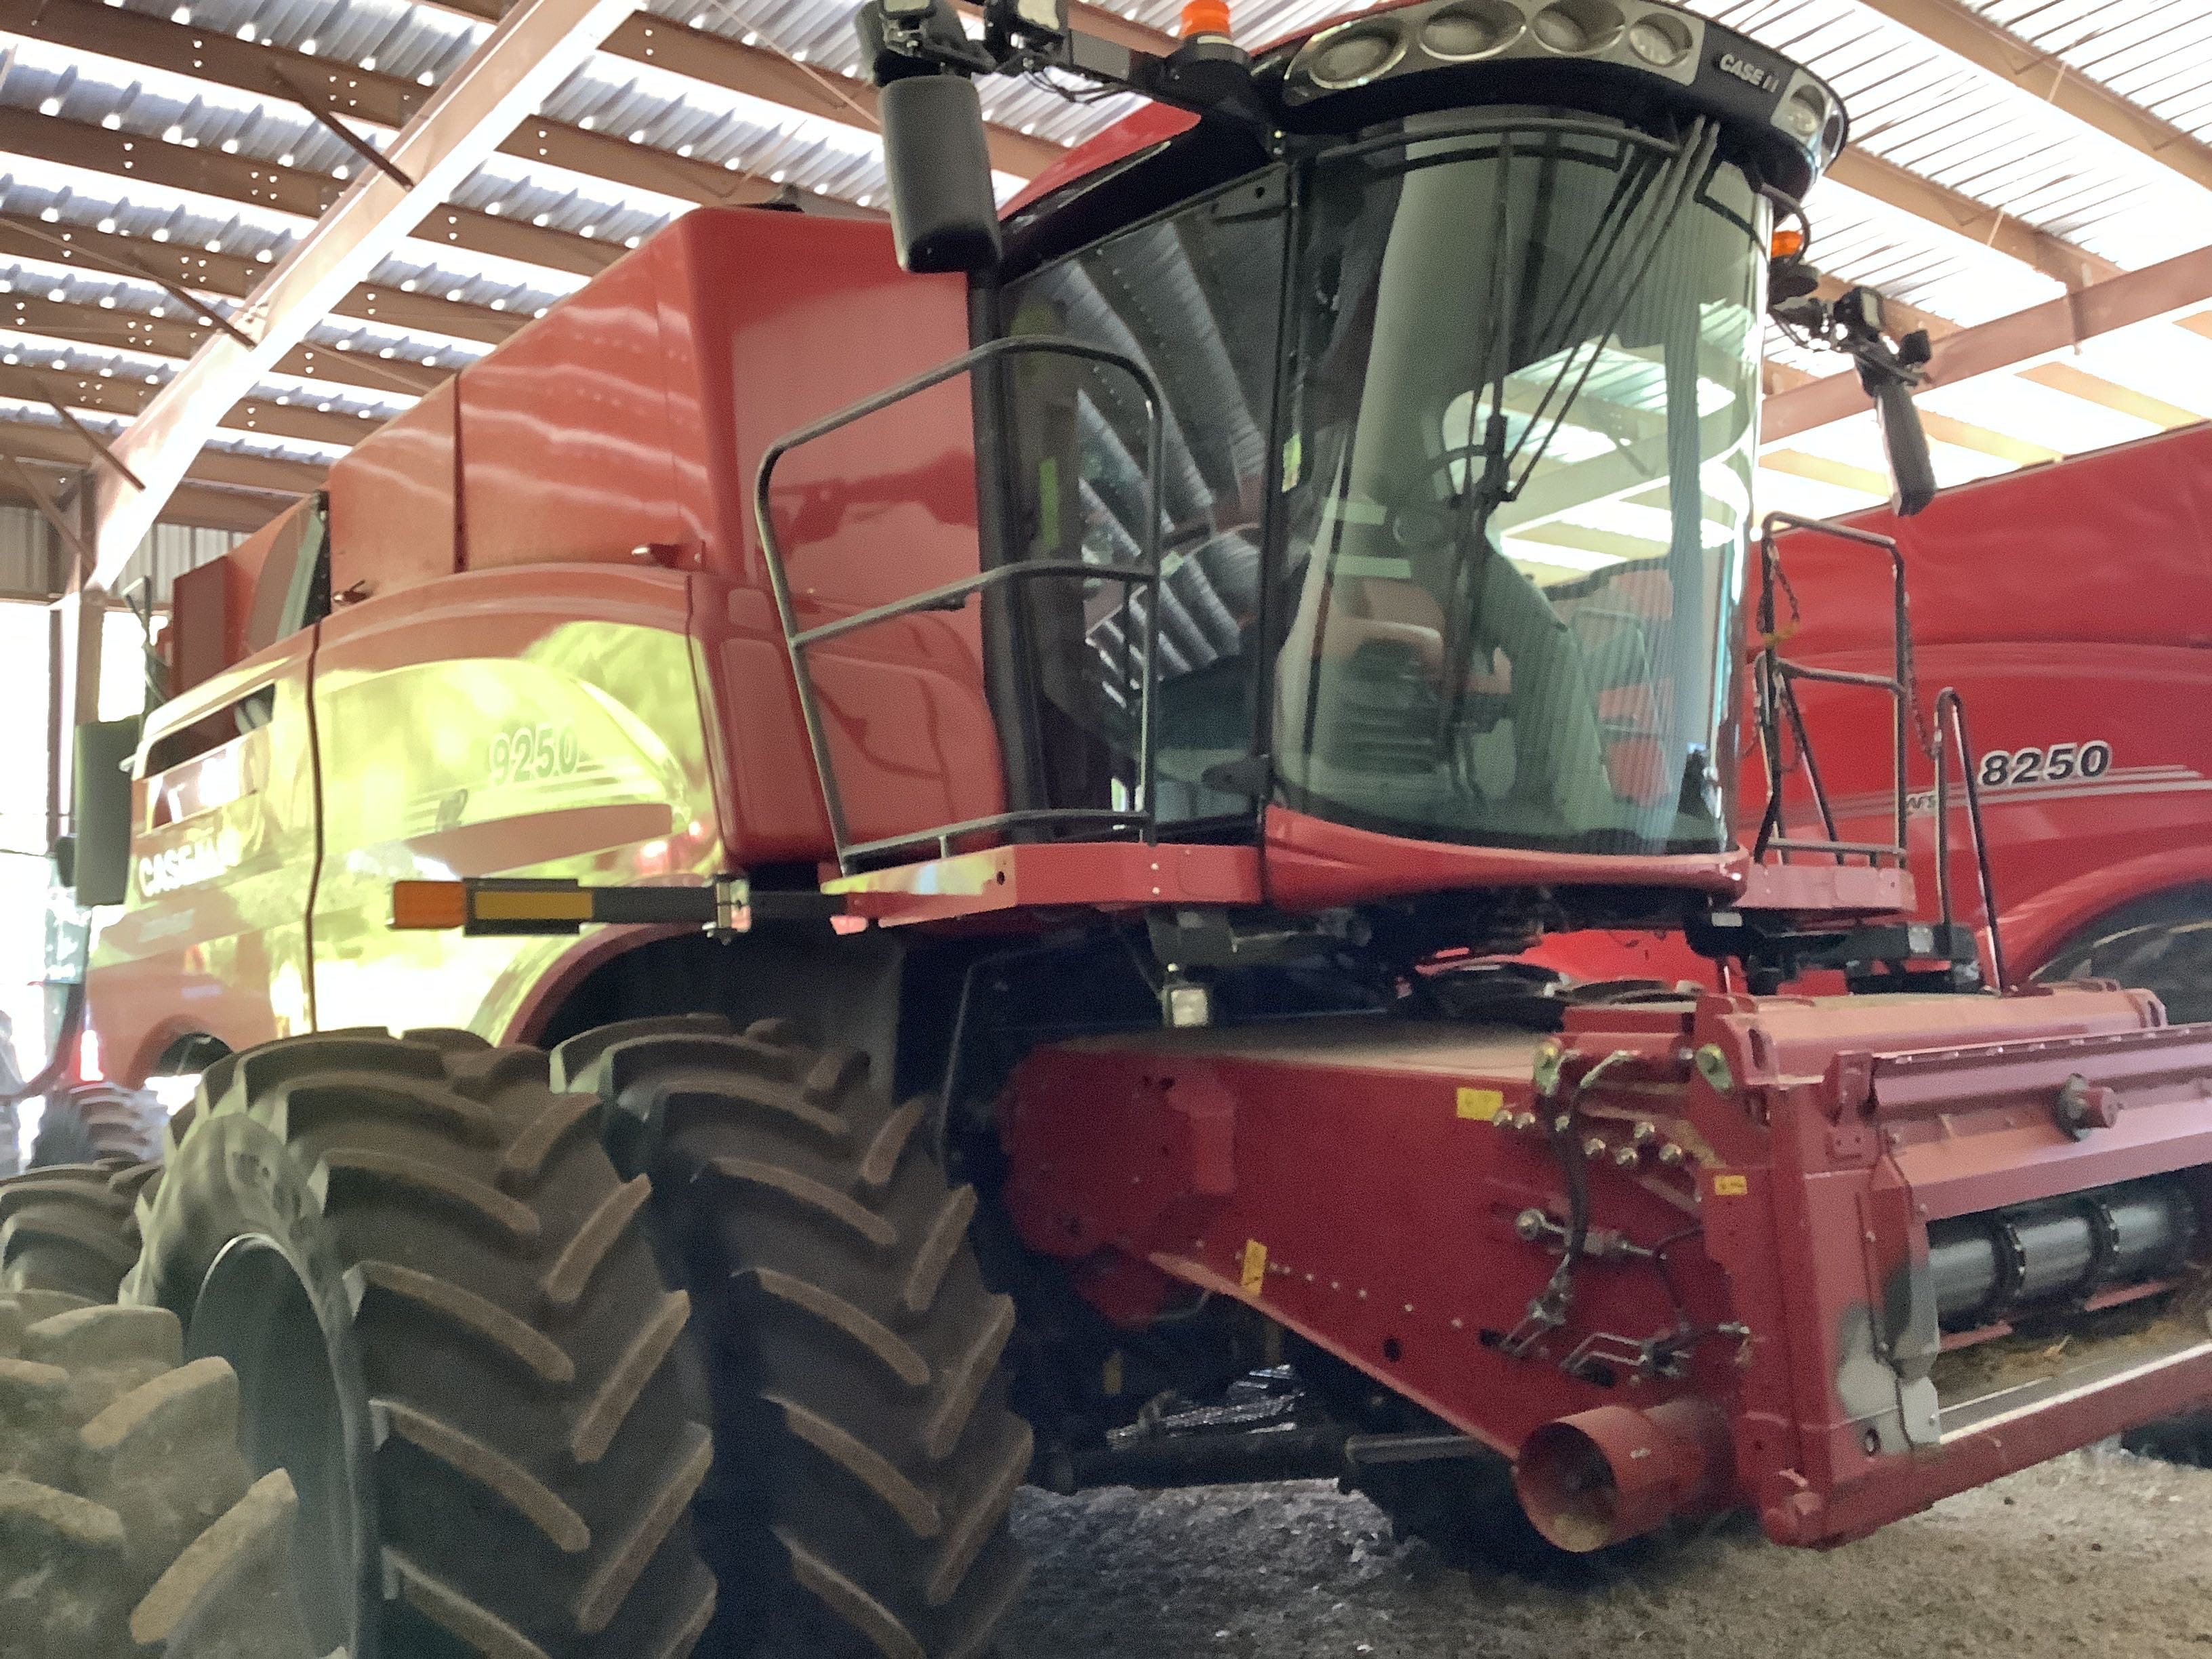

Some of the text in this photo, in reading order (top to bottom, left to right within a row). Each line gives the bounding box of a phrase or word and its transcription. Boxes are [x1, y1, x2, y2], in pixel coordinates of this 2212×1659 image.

[1719, 54, 1765, 86] CASE
[489, 724, 577, 788] 9250
[1979, 741, 2111, 786] 8250
